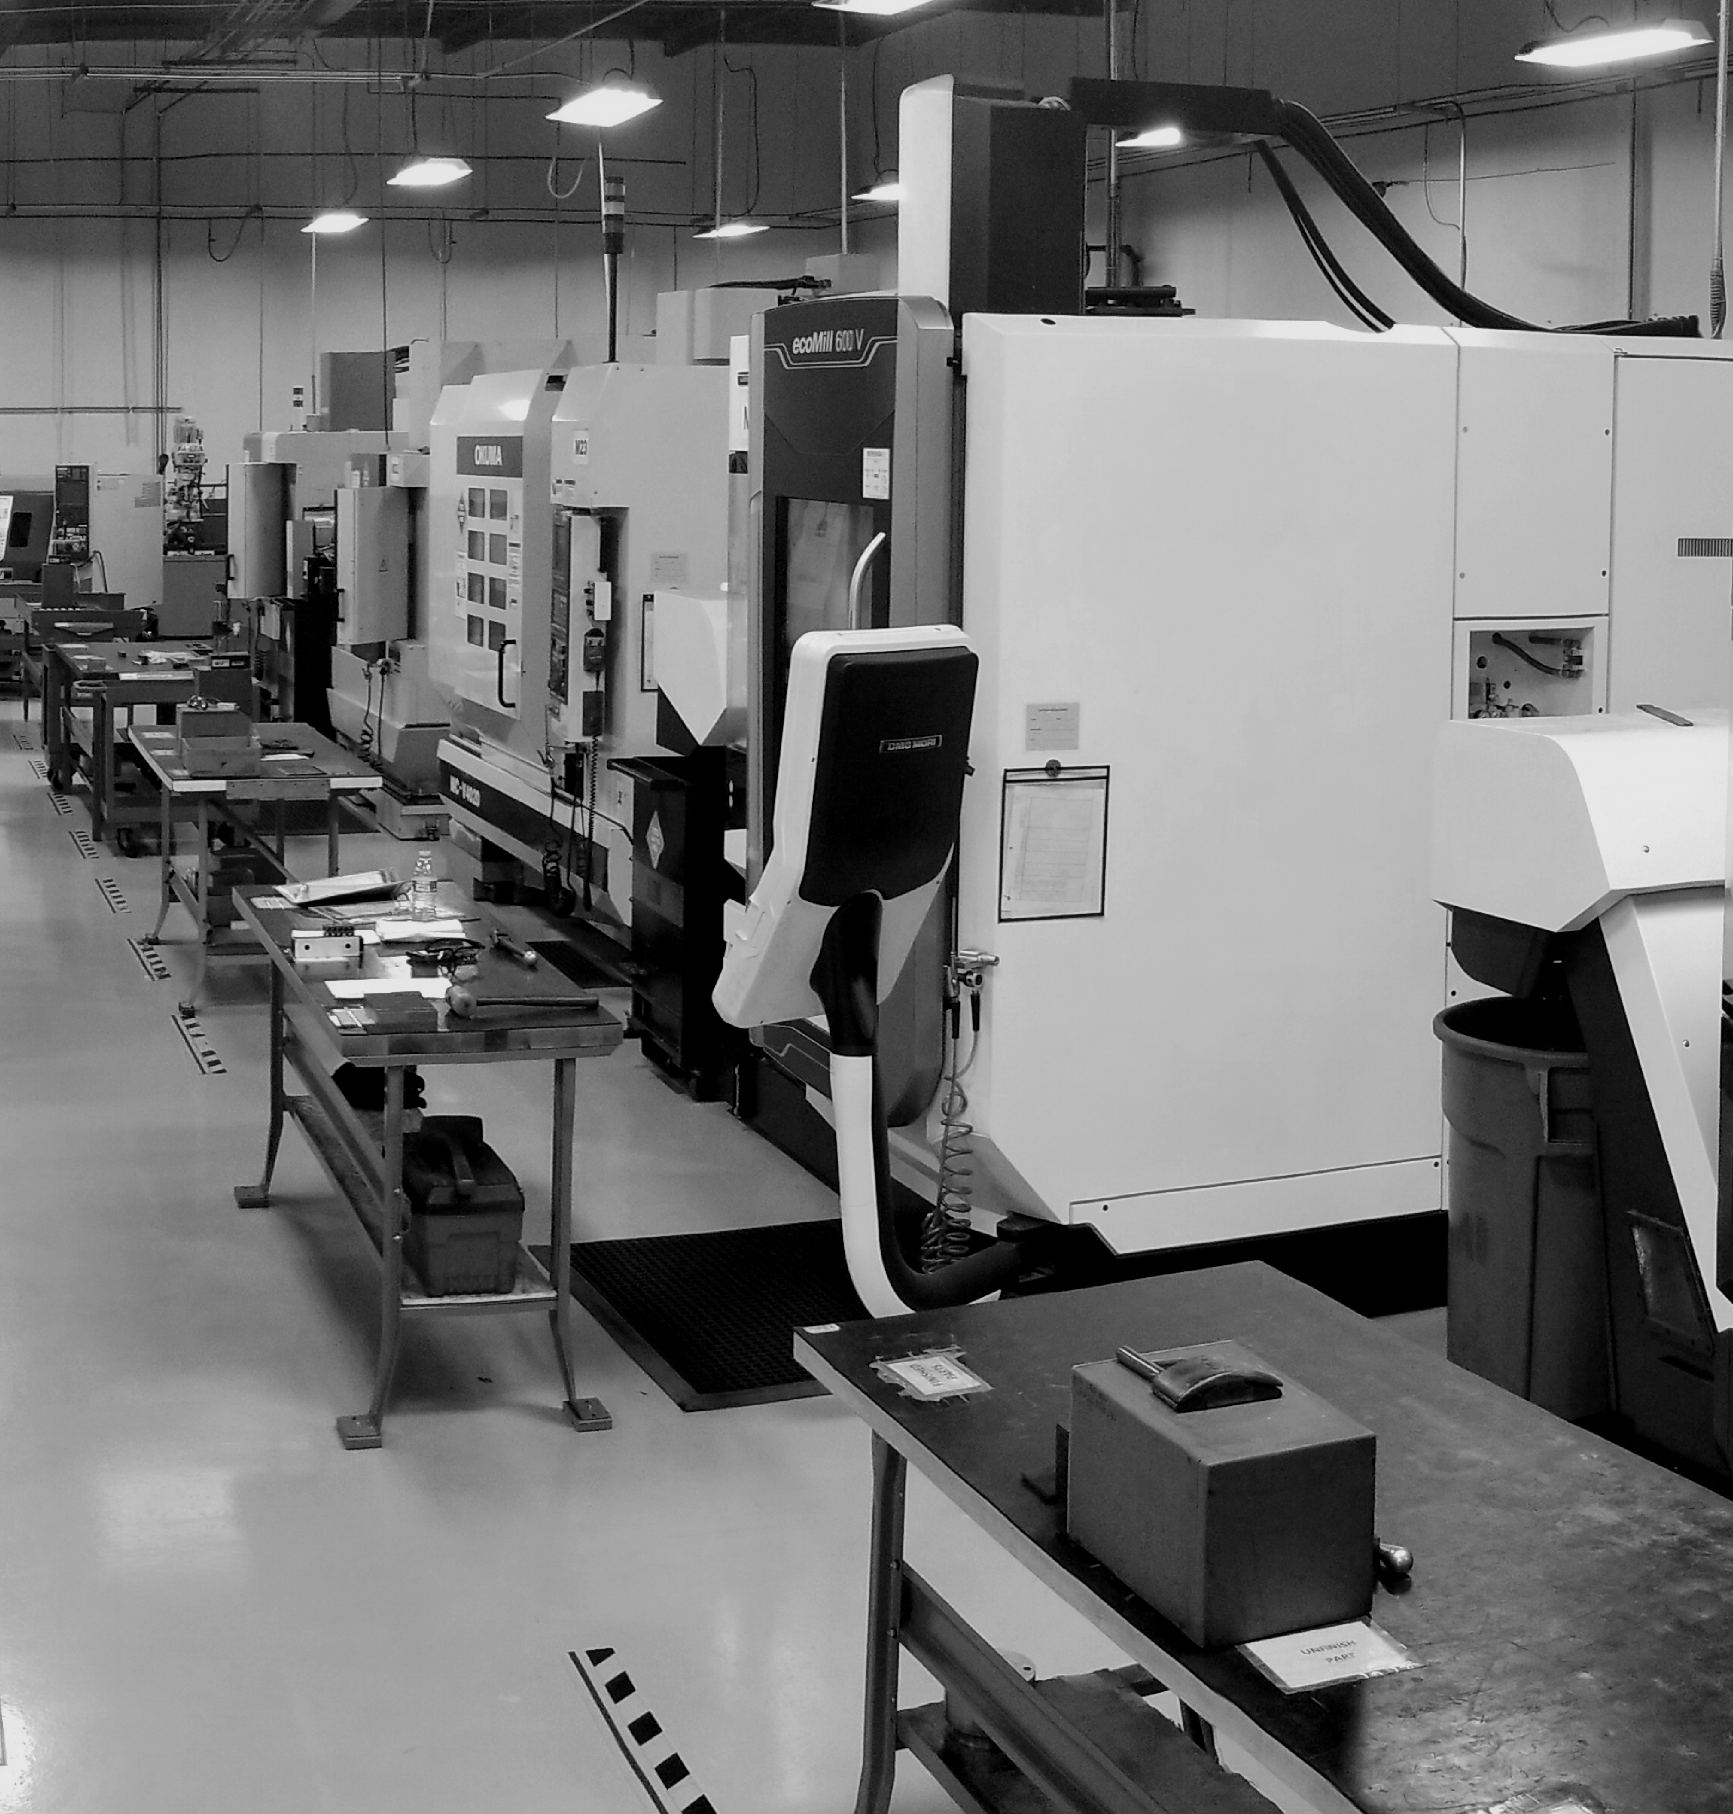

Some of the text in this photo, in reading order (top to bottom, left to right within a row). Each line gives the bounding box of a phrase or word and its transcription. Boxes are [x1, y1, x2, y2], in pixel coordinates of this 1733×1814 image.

[792, 329, 865, 354] ecoMill 600 V
[1300, 1639, 1357, 1656] UNFINISH
[1325, 1652, 1357, 1664] PART
